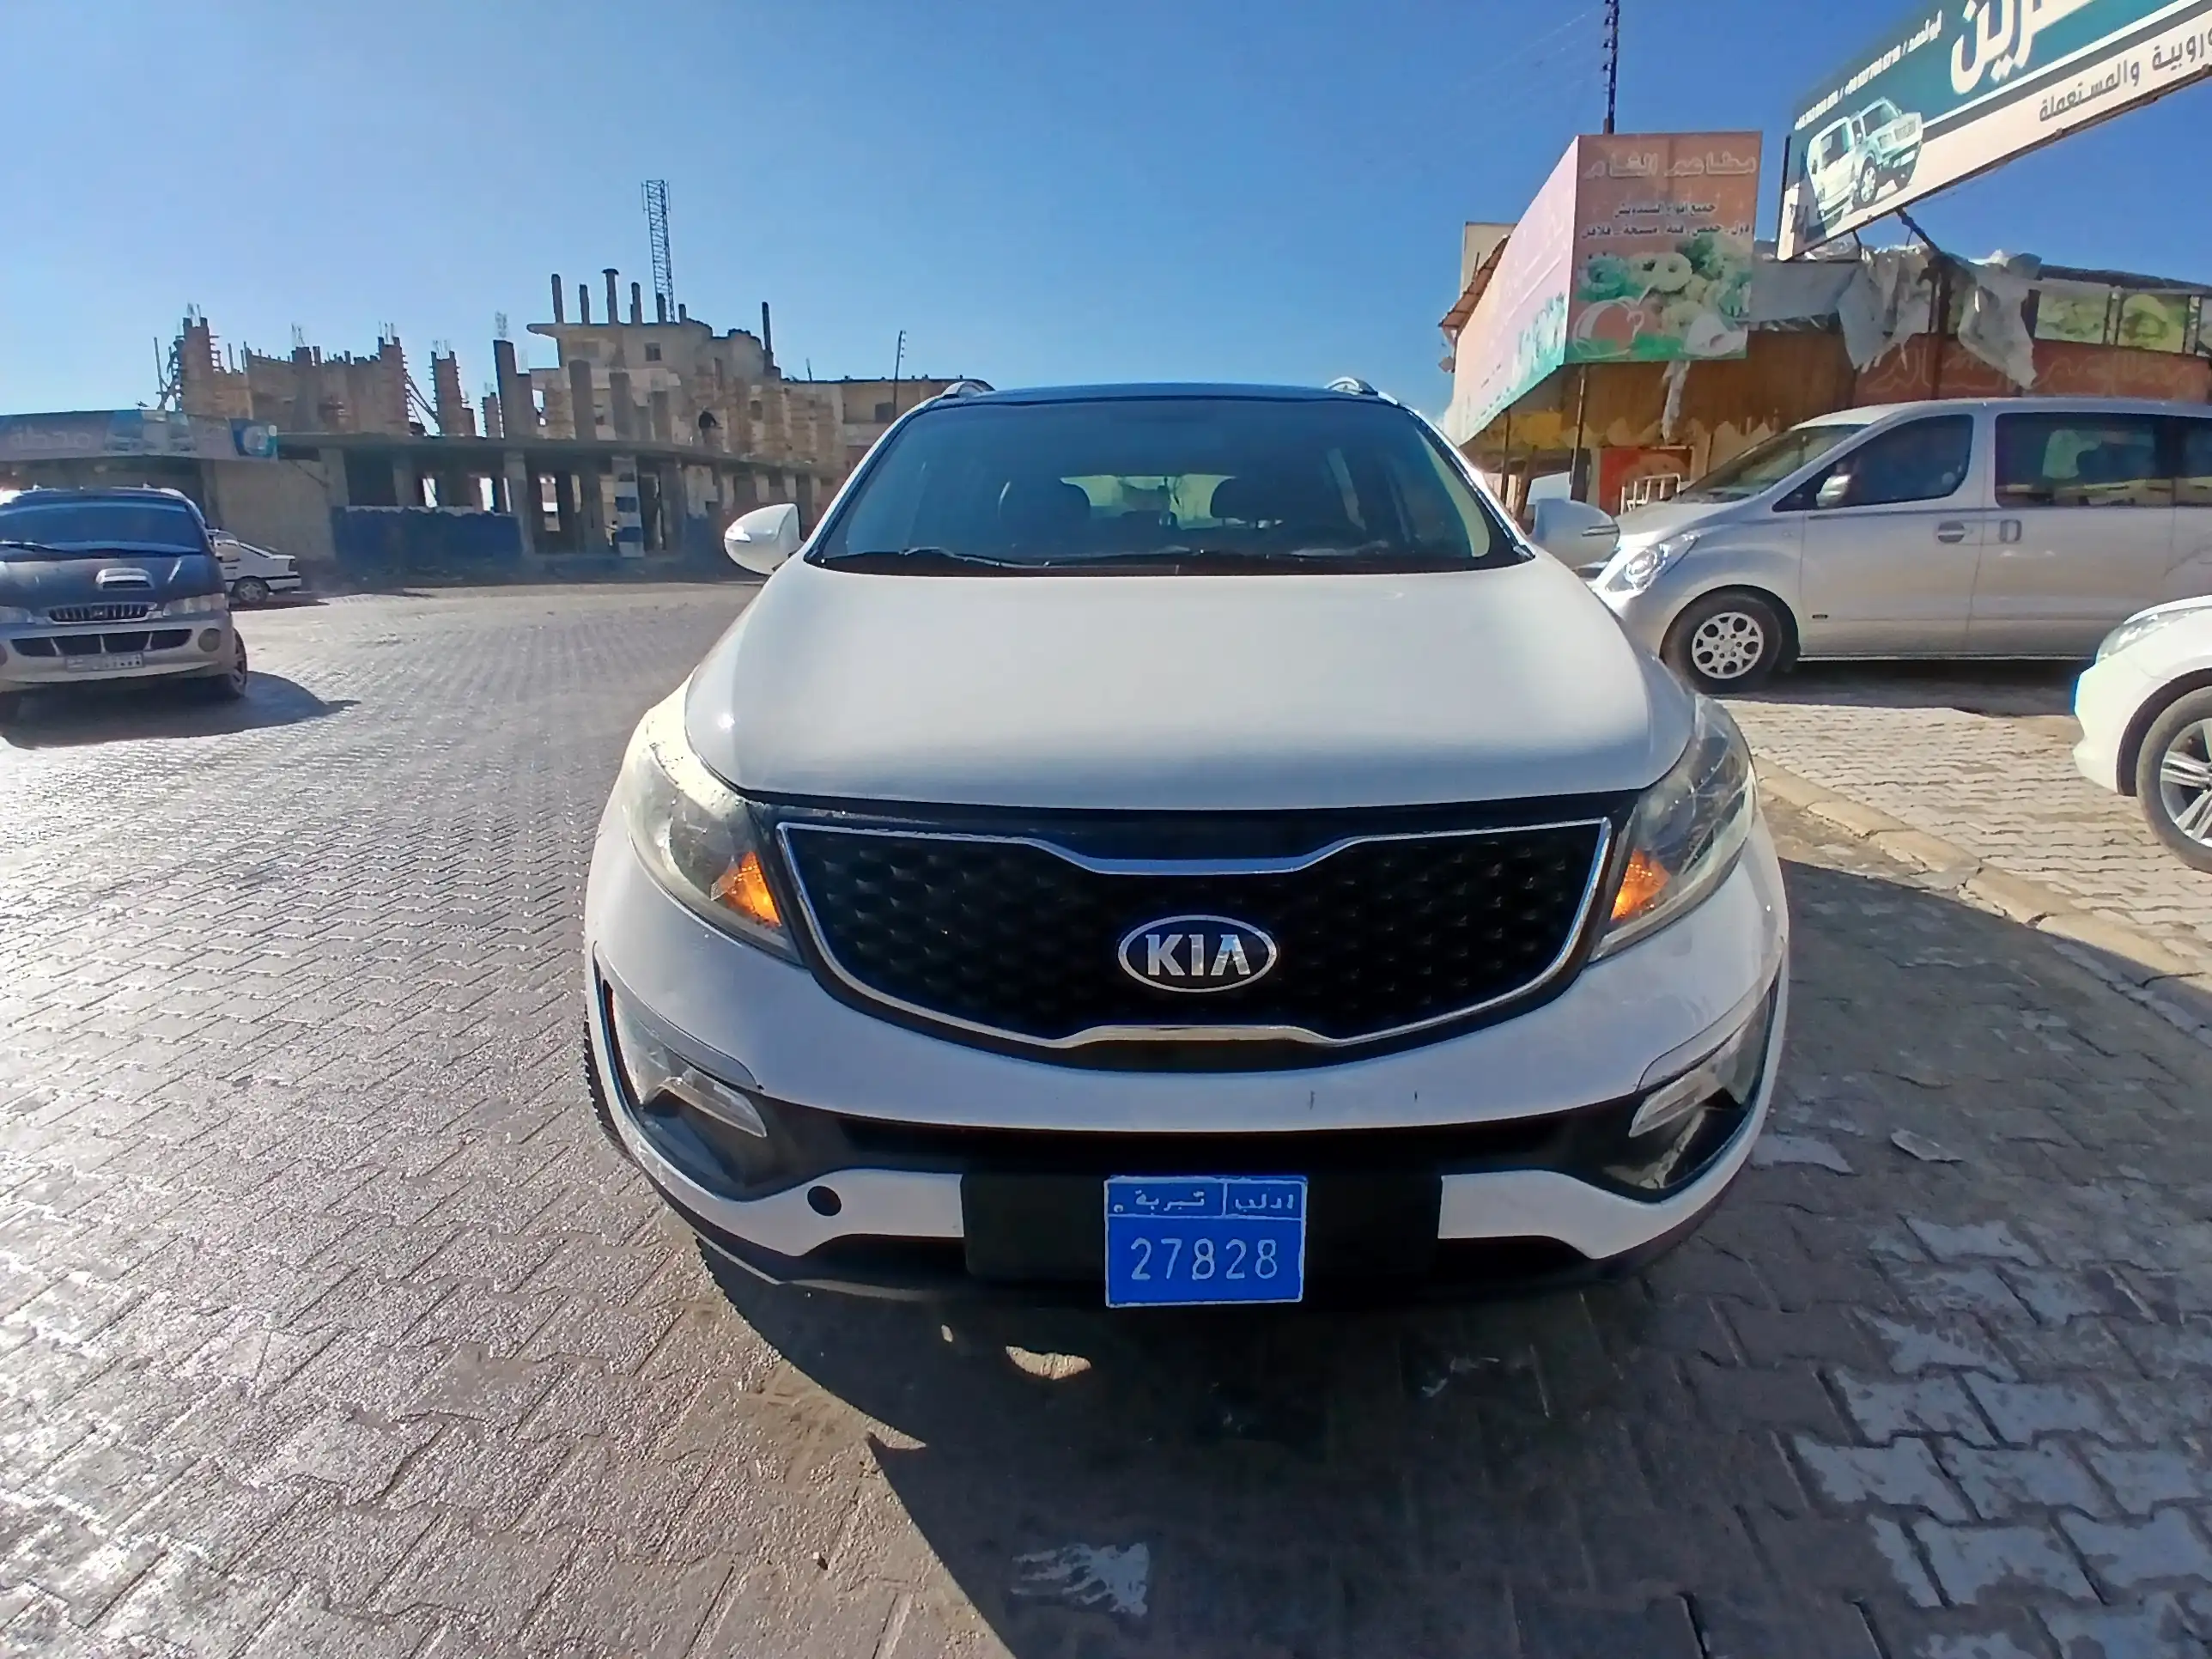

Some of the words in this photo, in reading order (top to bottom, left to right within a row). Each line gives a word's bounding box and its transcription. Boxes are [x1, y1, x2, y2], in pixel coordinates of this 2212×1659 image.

[2039, 58, 2141, 123] والمستعملة
[1145, 933, 1252, 976] KIA
[1130, 1237, 1279, 1280] 27828
